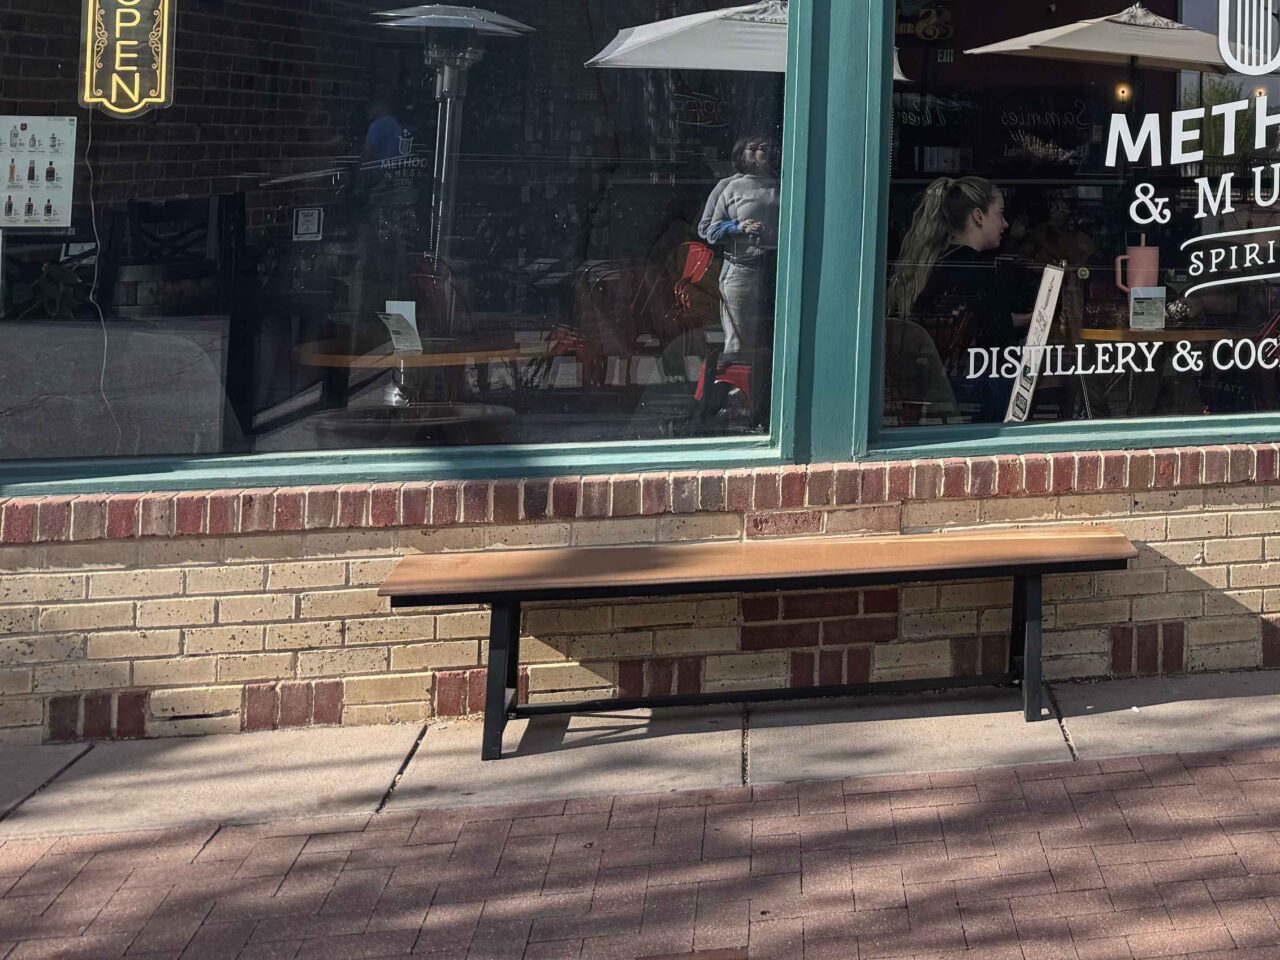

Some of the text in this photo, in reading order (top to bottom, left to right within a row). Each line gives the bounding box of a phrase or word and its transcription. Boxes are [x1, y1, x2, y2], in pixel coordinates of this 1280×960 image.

[937, 49, 954, 62] EXIT
[380, 156, 428, 170] METHOD
[1129, 183, 1171, 225] &
[966, 341, 1164, 380] DISTILLERY
[1171, 340, 1204, 372] &
